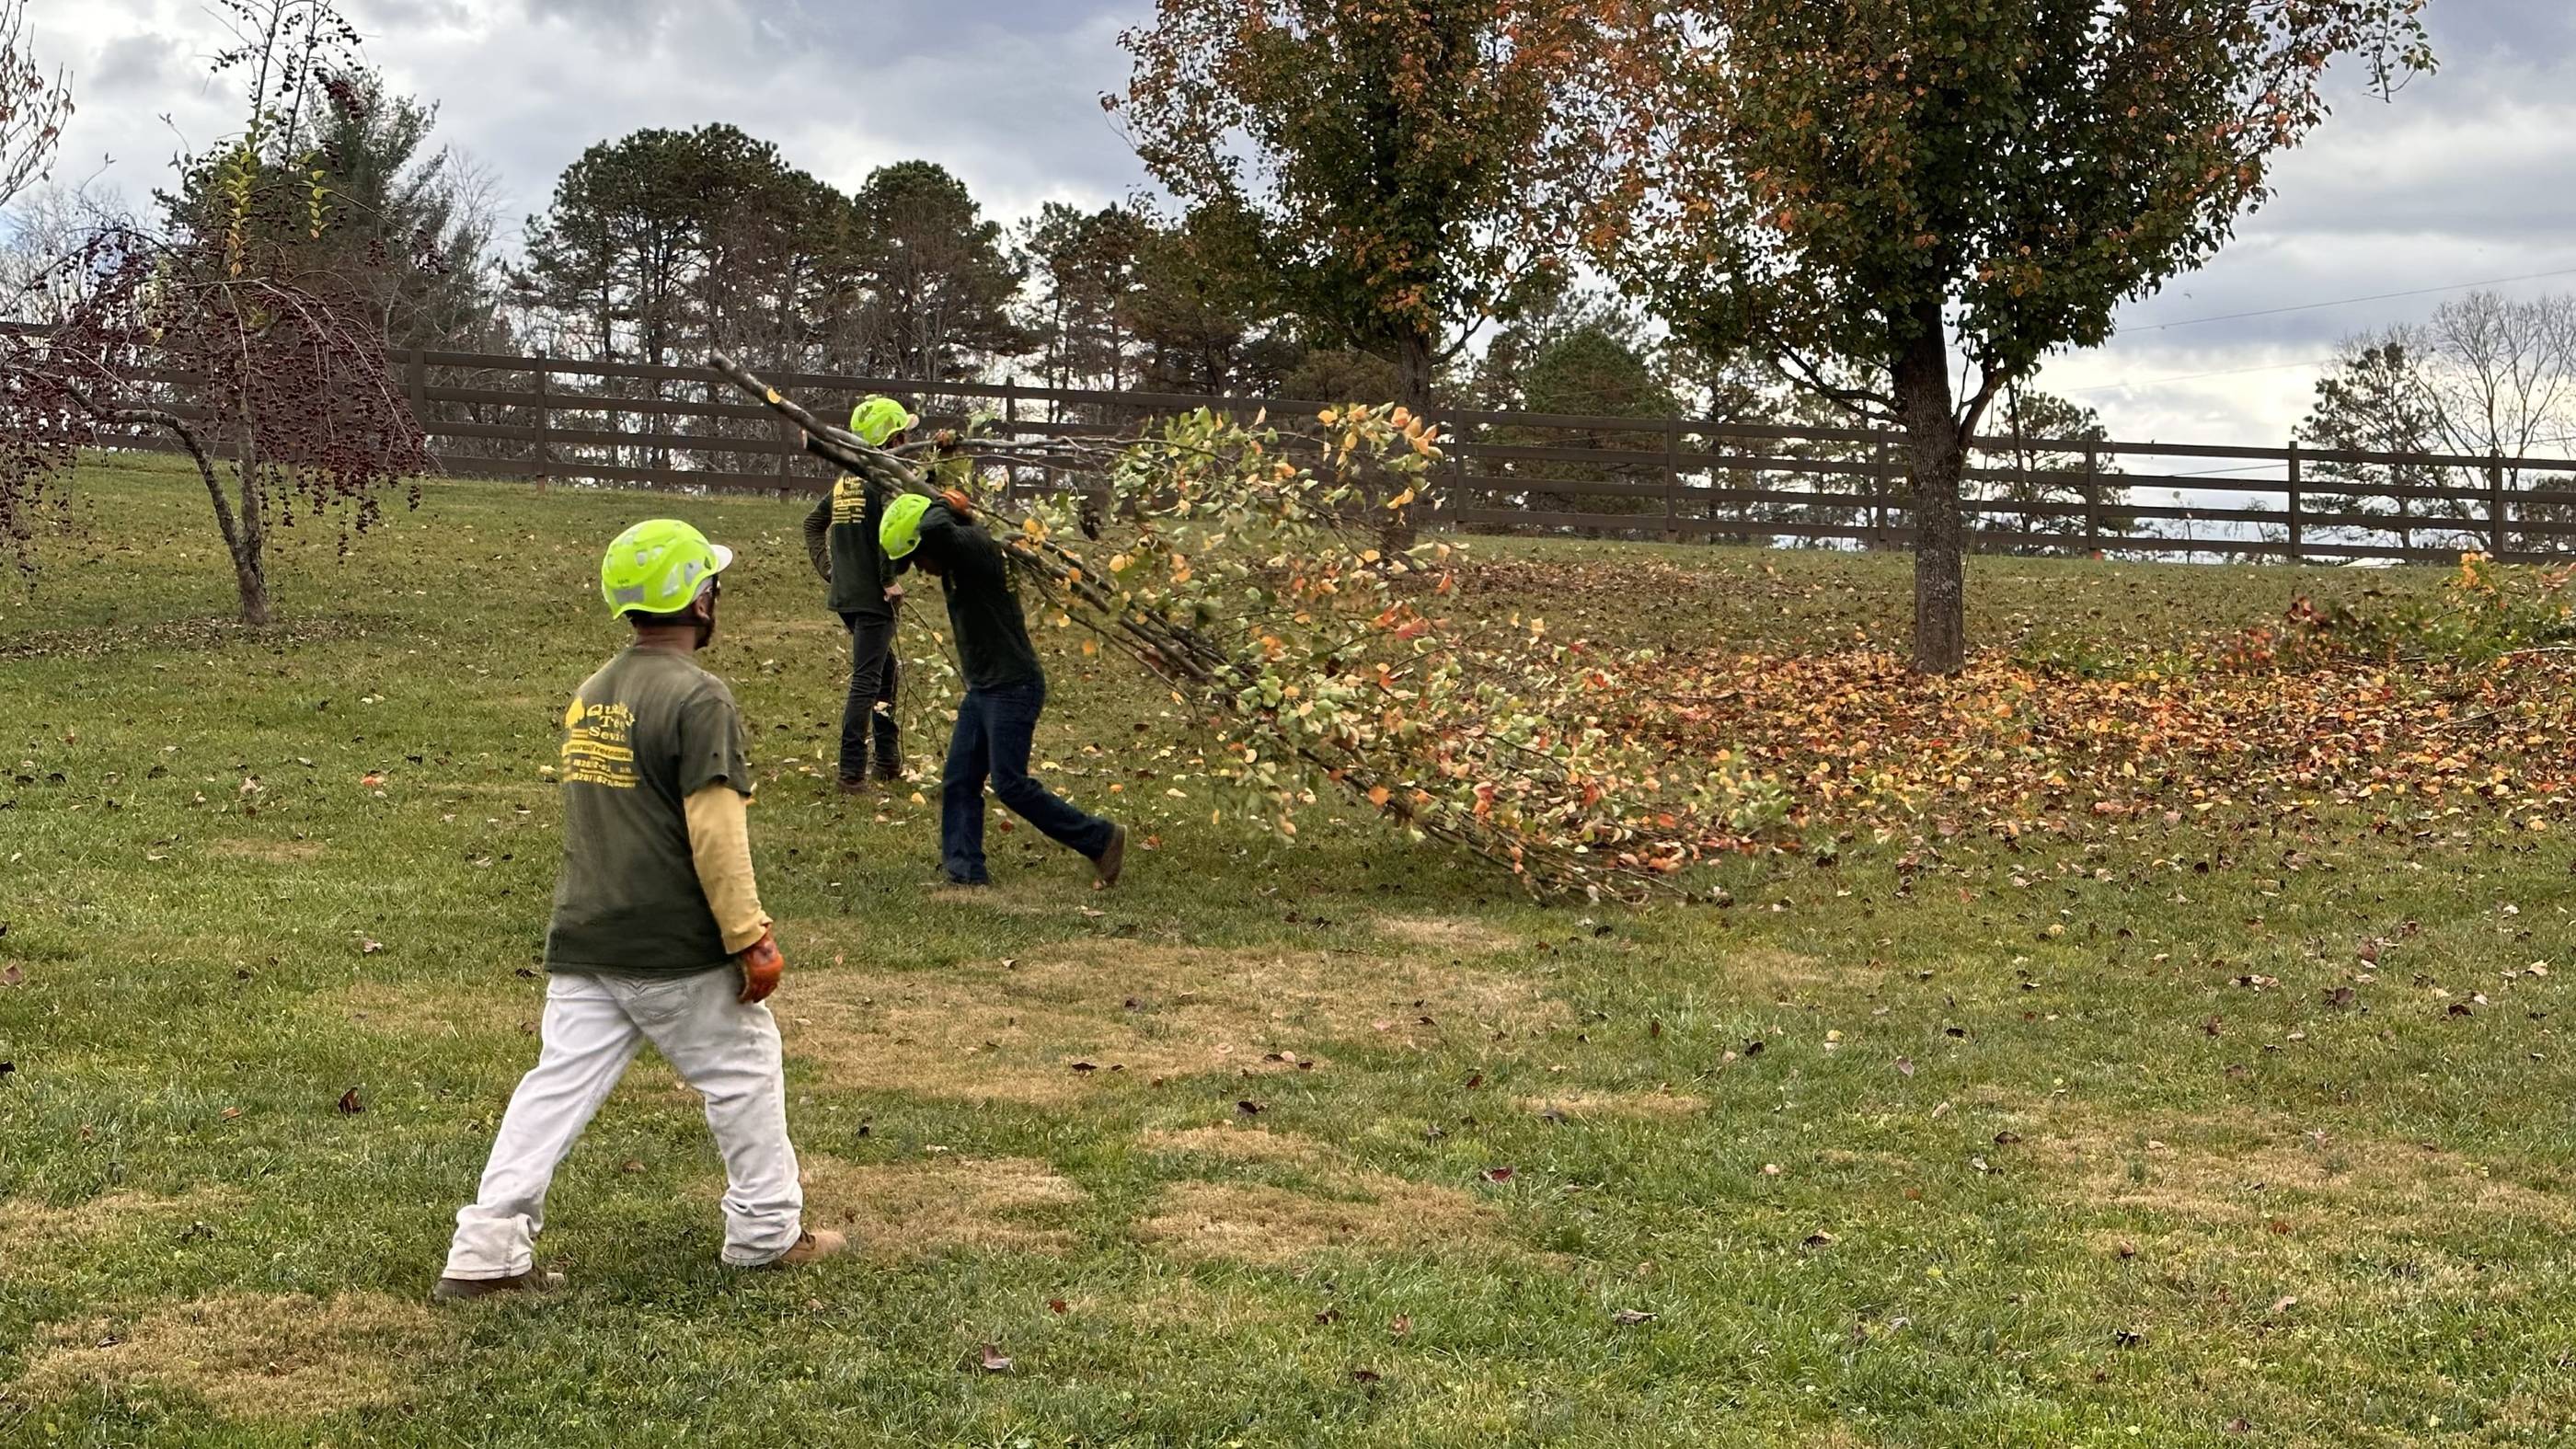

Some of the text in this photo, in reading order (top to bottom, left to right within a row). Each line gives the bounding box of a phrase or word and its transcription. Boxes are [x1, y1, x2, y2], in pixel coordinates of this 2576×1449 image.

[587, 702, 635, 727] Quality
[599, 715, 626, 731] Tee
[588, 726, 627, 743] Sevic
